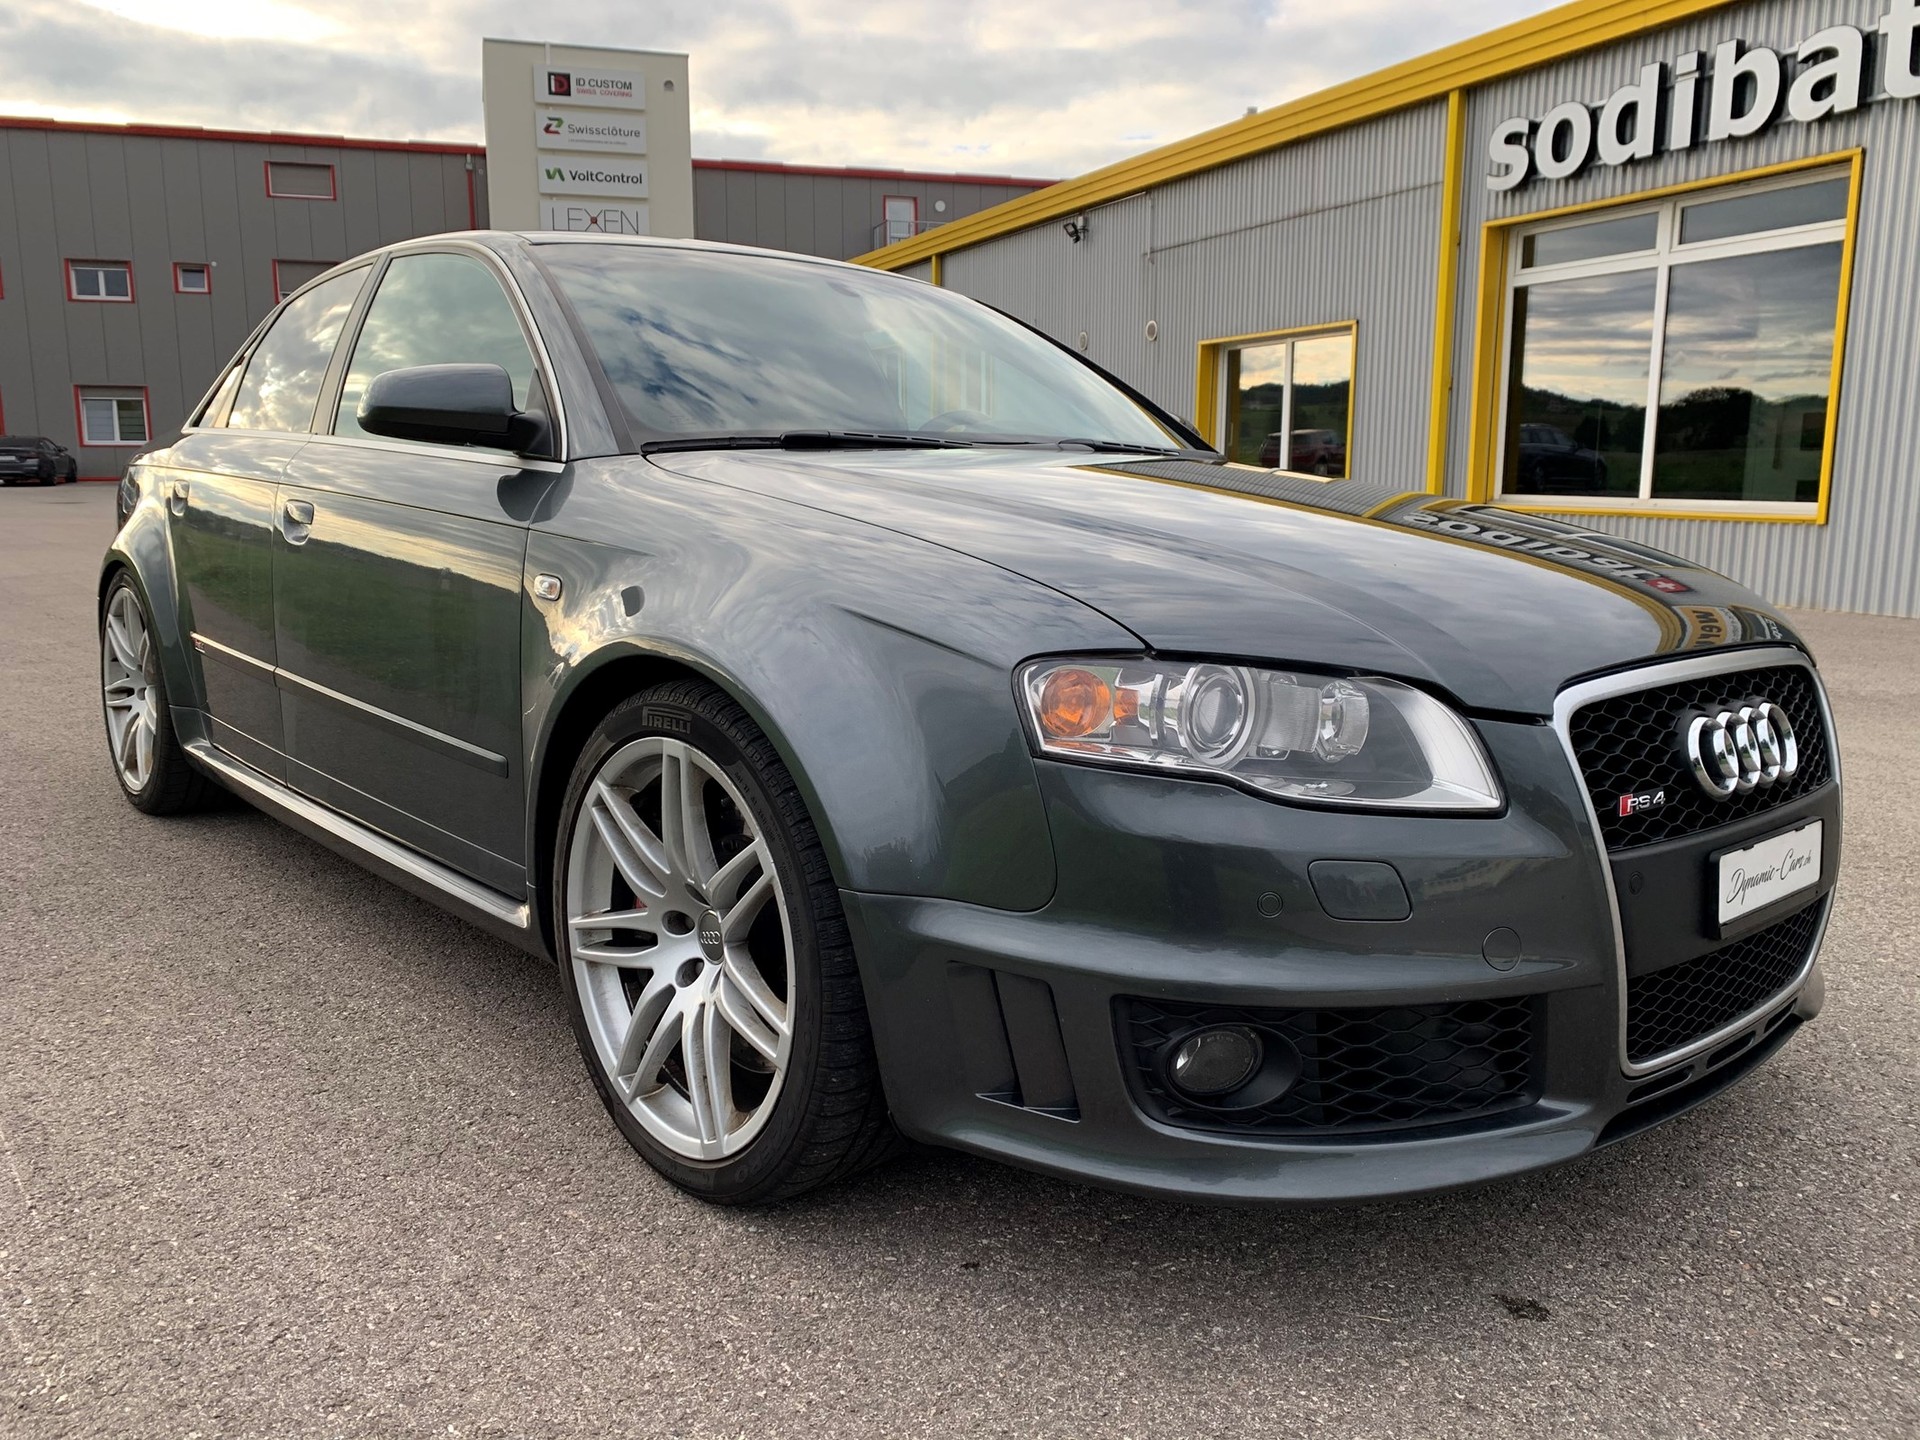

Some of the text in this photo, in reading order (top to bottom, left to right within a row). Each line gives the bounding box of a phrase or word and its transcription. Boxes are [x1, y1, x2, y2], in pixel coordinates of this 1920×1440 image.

[575, 77, 632, 90] ID CUSTOM
[1487, 0, 1920, 191] sodibat
[567, 123, 641, 138] Swissclôture
[568, 169, 643, 184] VoltControl
[551, 206, 639, 235] LEXEN
[641, 706, 693, 734] PIRELLI
